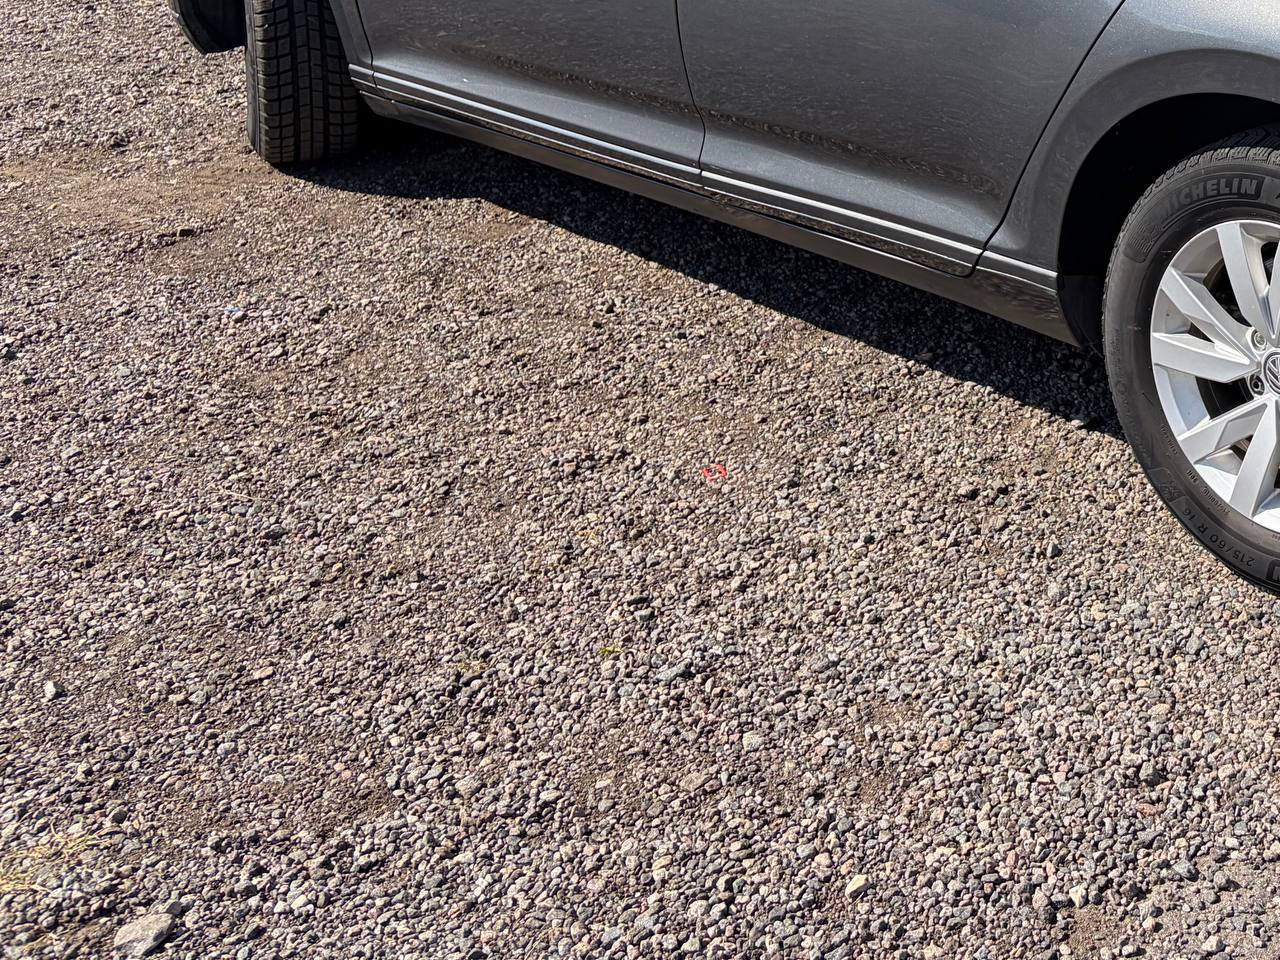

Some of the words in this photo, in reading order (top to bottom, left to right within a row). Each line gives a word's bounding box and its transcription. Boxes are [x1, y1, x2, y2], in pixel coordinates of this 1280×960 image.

[1163, 178, 1259, 218] MICHELIN
[1182, 508, 1196, 520] 16
[1198, 523, 1208, 533] R
[1210, 534, 1255, 566] 215/60
